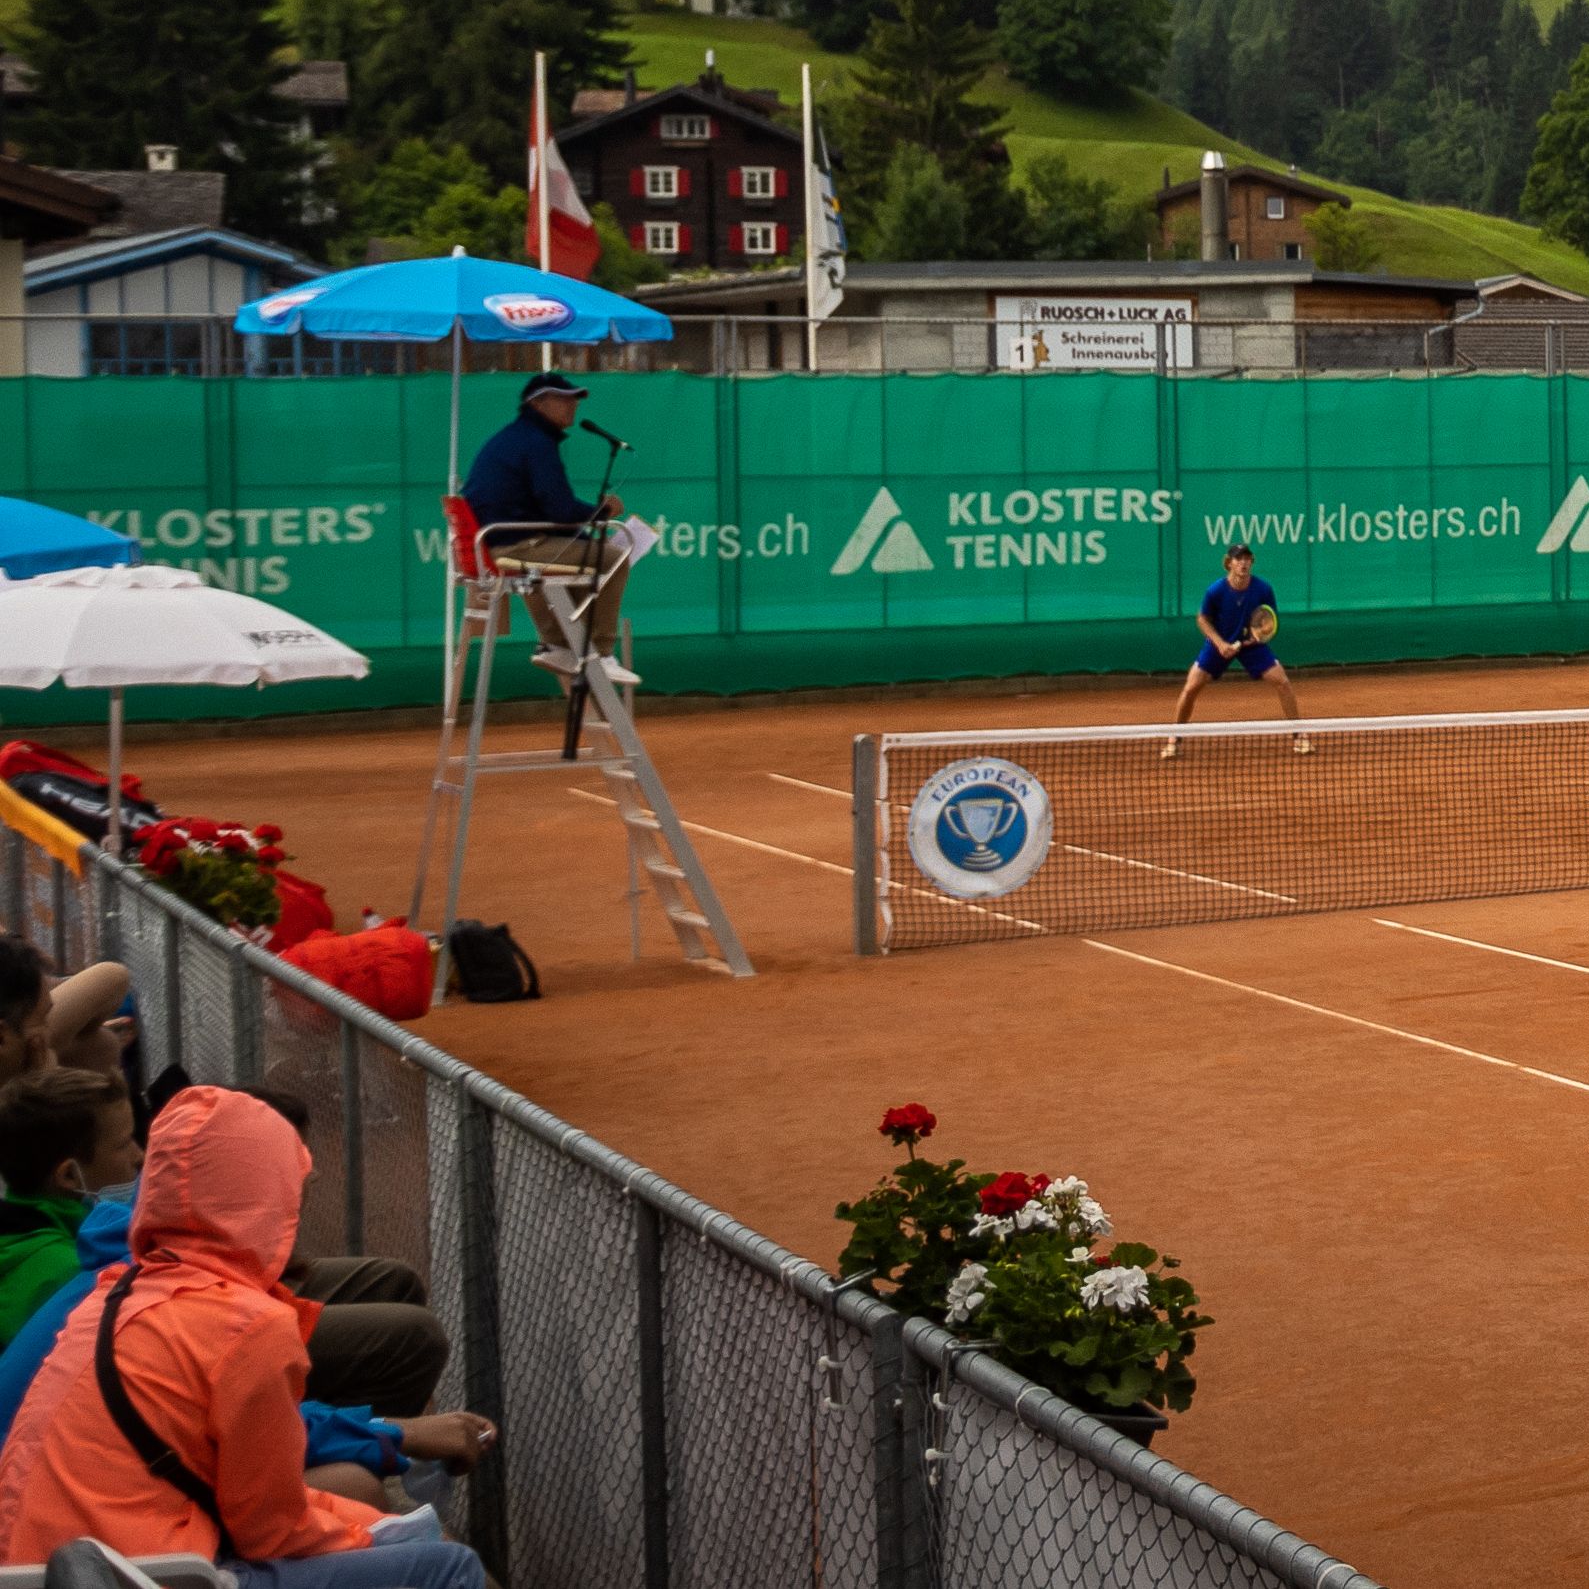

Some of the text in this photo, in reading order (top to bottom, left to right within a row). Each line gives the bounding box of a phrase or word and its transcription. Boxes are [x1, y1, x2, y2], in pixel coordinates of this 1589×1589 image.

[1041, 306, 1105, 321] RUOSCH
[1119, 308, 1159, 321] LUCK
[1164, 310, 1187, 321] AG
[1015, 344, 1025, 363] 1
[1061, 332, 1145, 346] Schreinerei
[948, 487, 1173, 527] KLOSTERS
[1204, 496, 1521, 546] www.klosters.ch
[946, 529, 1107, 570] TENNIS
[932, 767, 1030, 802] EUROPEAN
